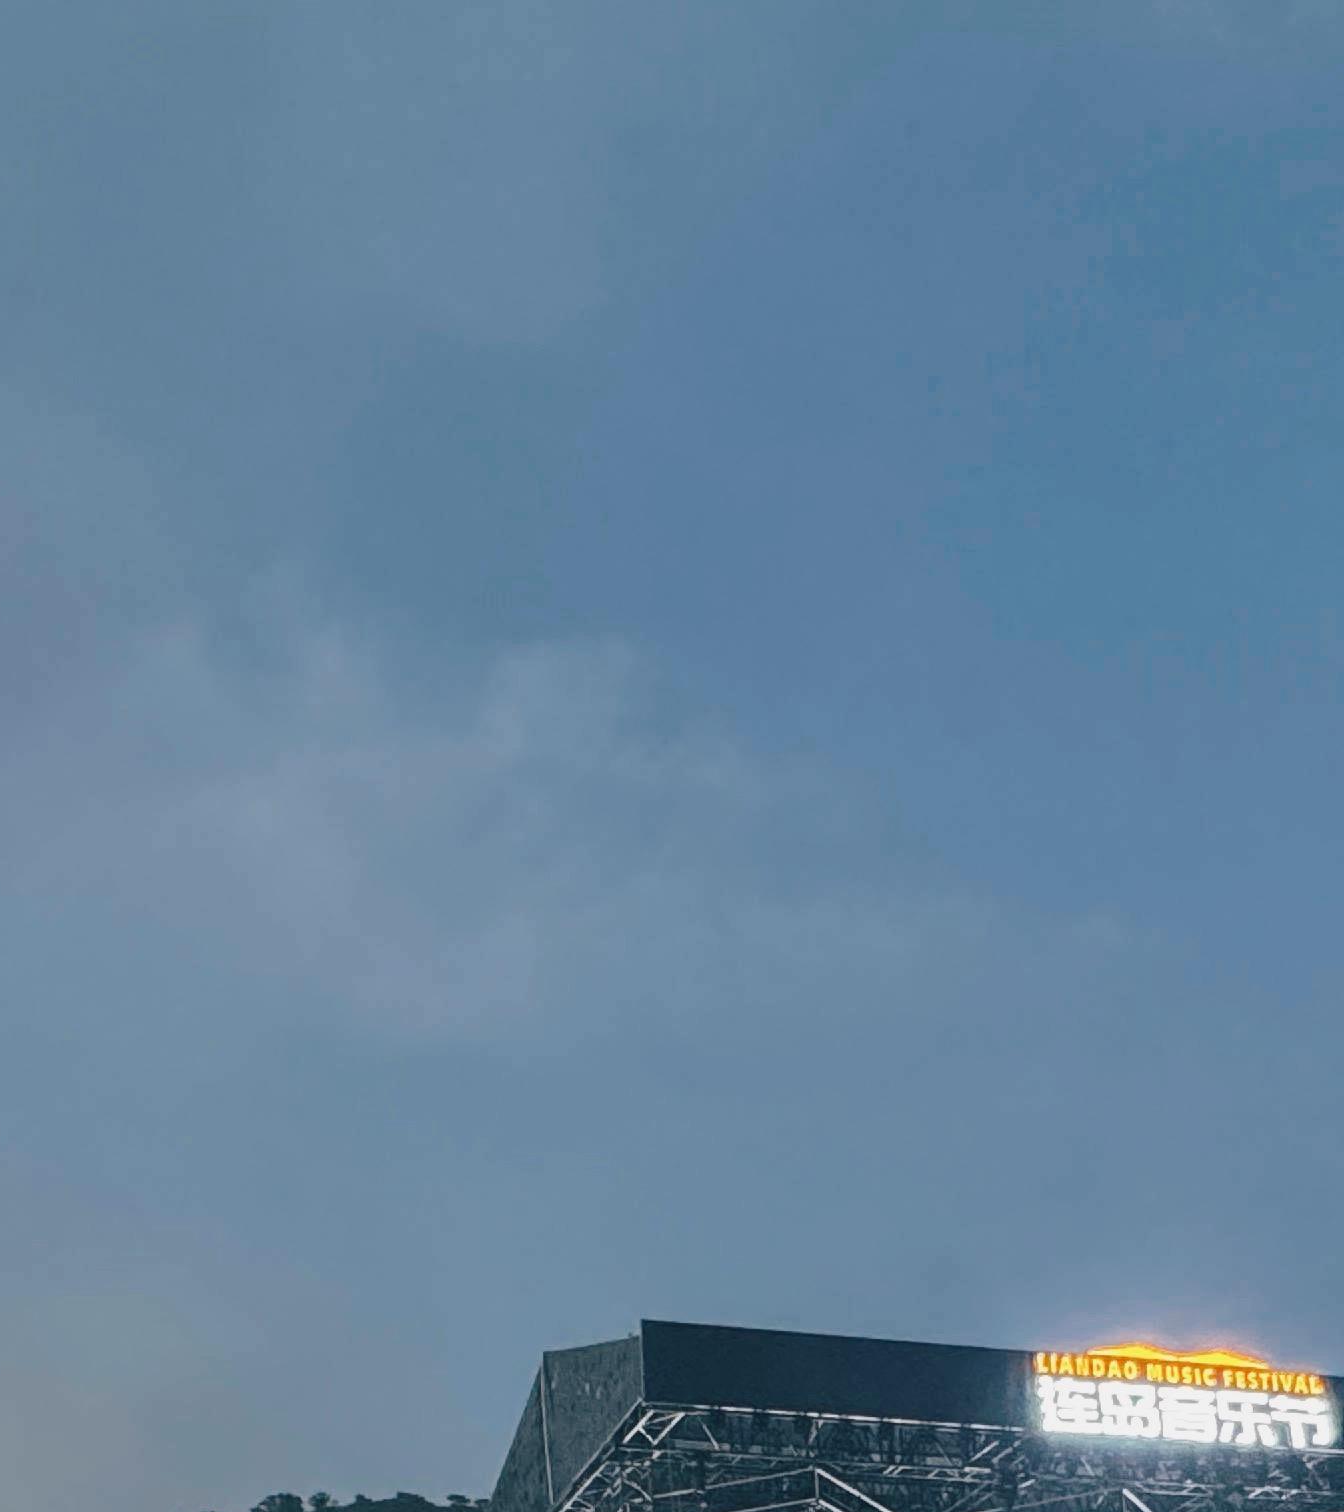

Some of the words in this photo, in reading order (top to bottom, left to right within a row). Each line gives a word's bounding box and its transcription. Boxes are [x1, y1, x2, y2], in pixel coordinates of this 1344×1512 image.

[1036, 1352, 1138, 1380] LIANDAO
[1146, 1362, 1217, 1388] MUSIC
[1222, 1369, 1324, 1395] FESTIVAL
[1036, 1375, 1331, 1449] 连岛音乐节
